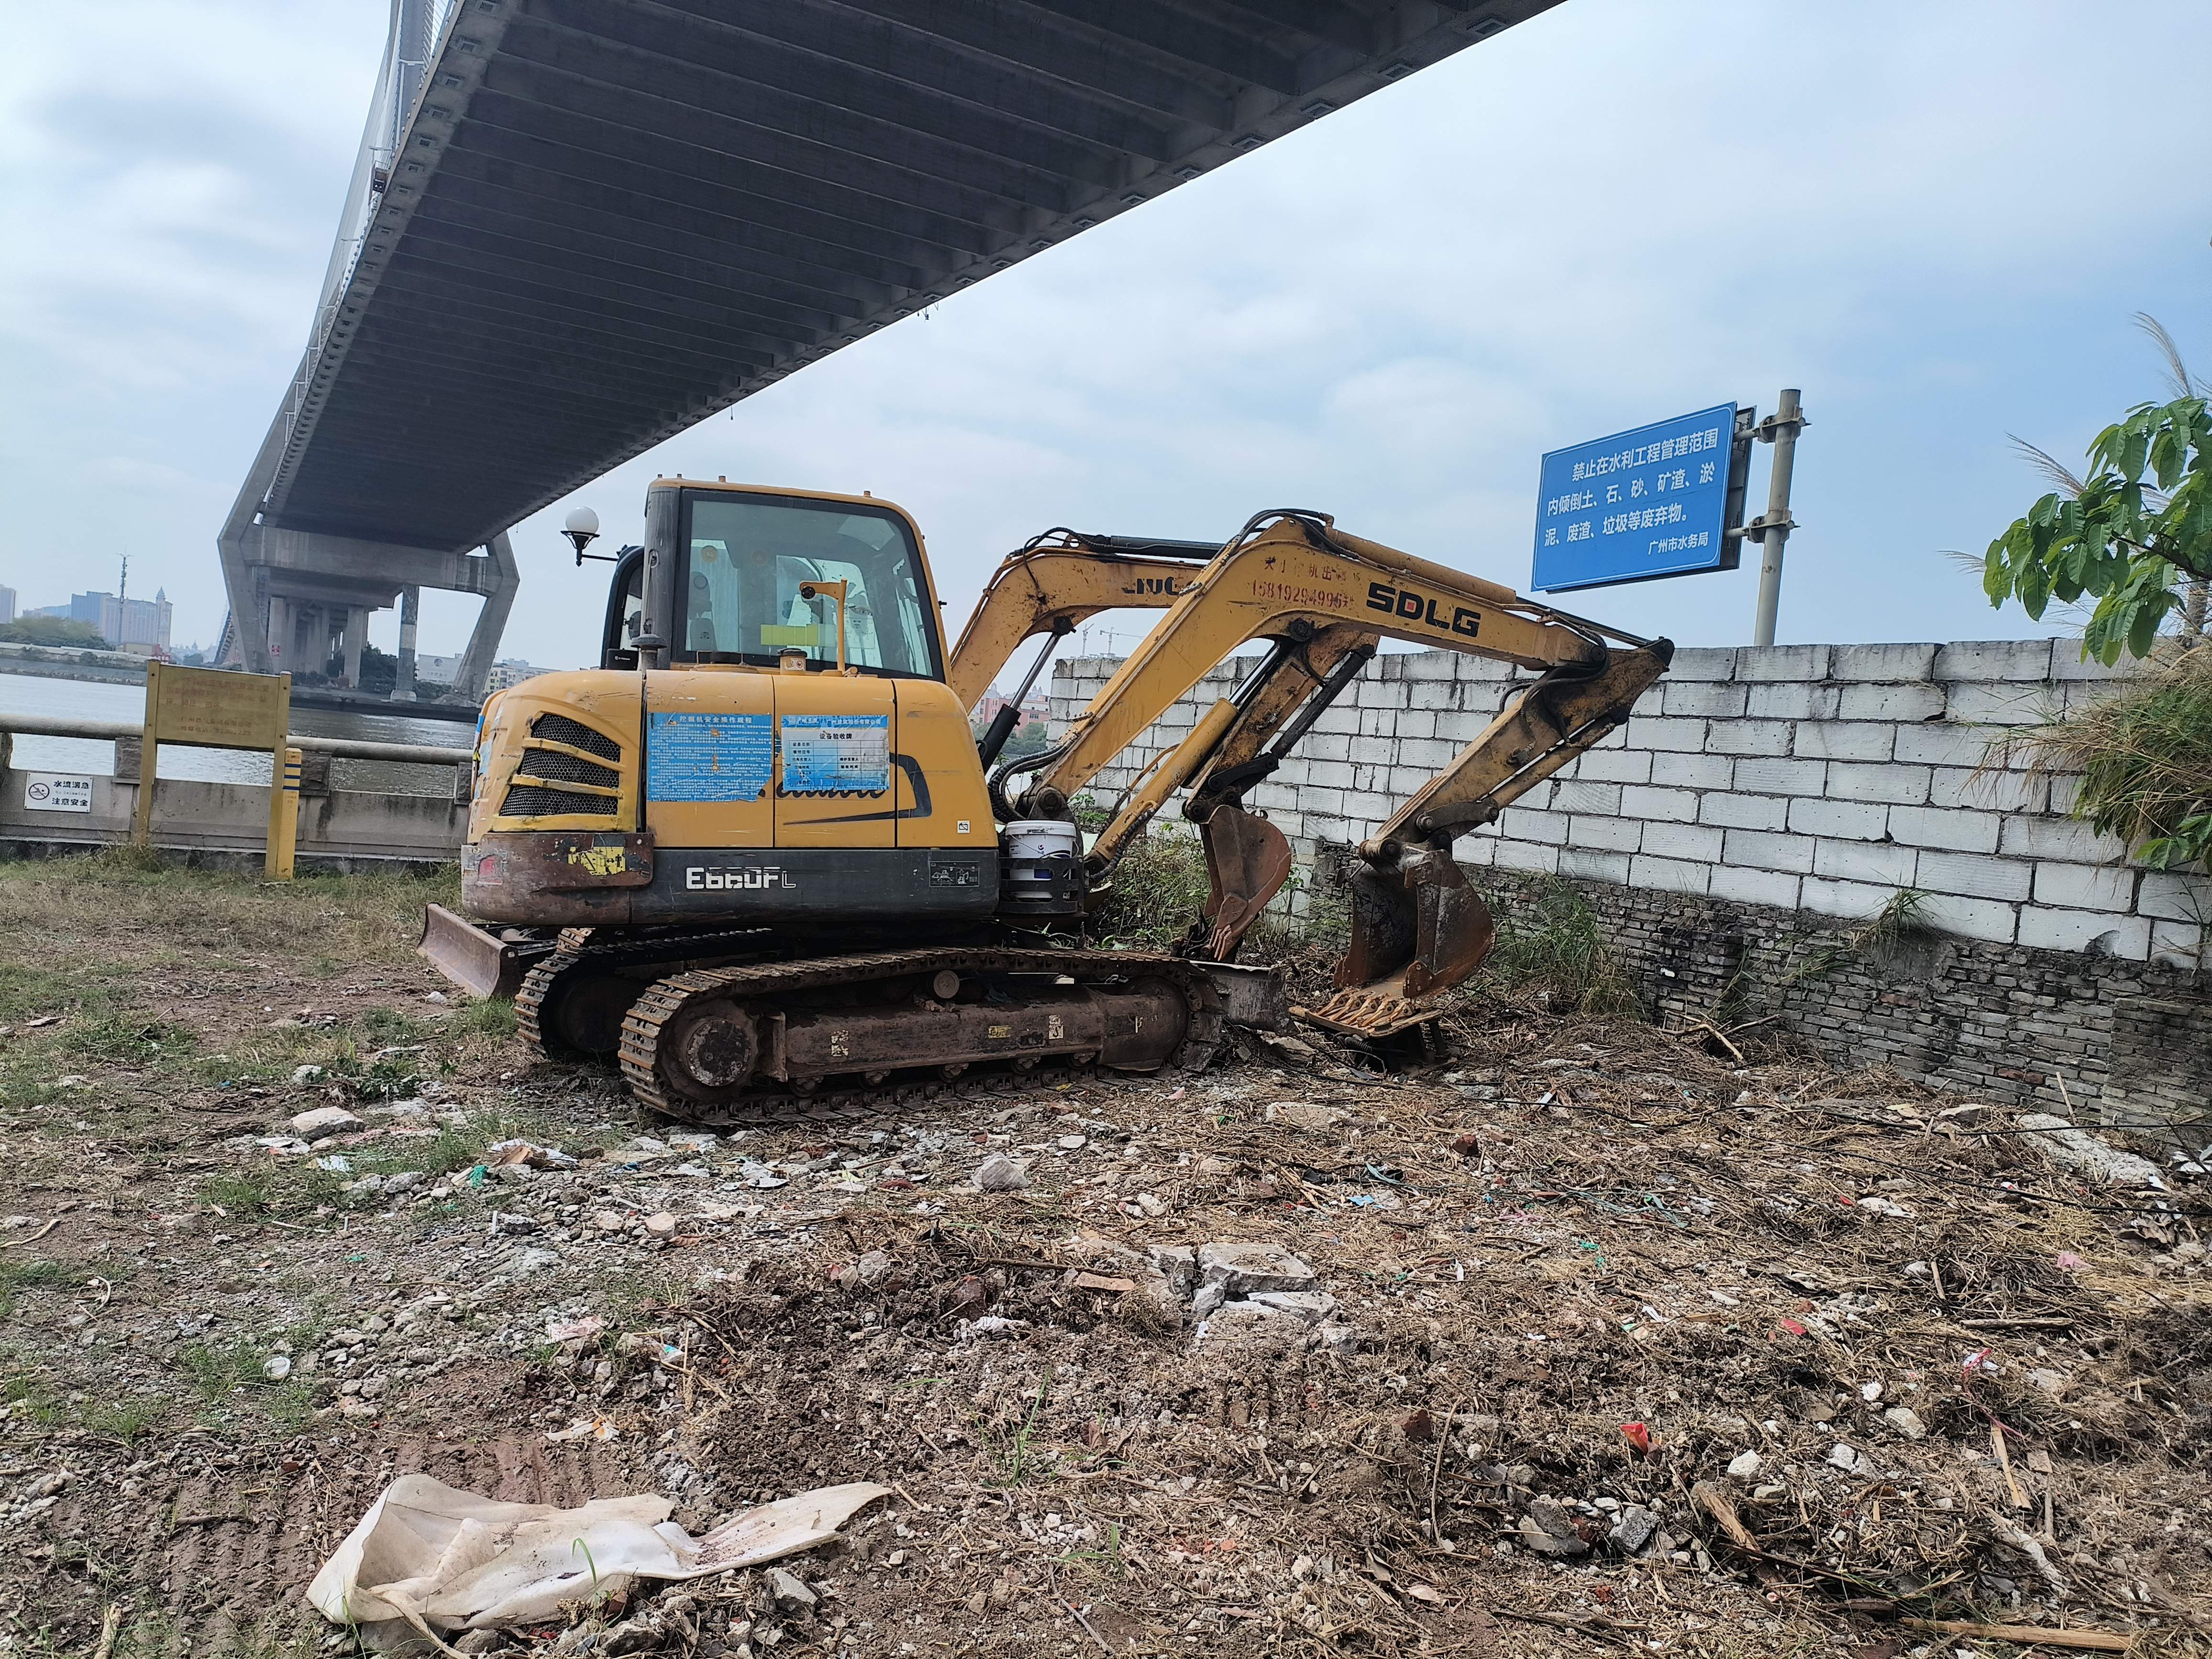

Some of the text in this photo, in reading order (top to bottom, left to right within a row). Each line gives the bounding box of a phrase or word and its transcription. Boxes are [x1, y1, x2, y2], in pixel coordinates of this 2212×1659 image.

[1572, 428, 1719, 482] 禁止在水利工程管理范围
[1648, 531, 1709, 555] 广州市水务局
[1366, 582, 1481, 638] SDLG
[679, 716, 752, 724] 挖掘机安全操作规程
[54, 780, 89, 789] 水流湍急
[52, 797, 88, 806] 注意安全
